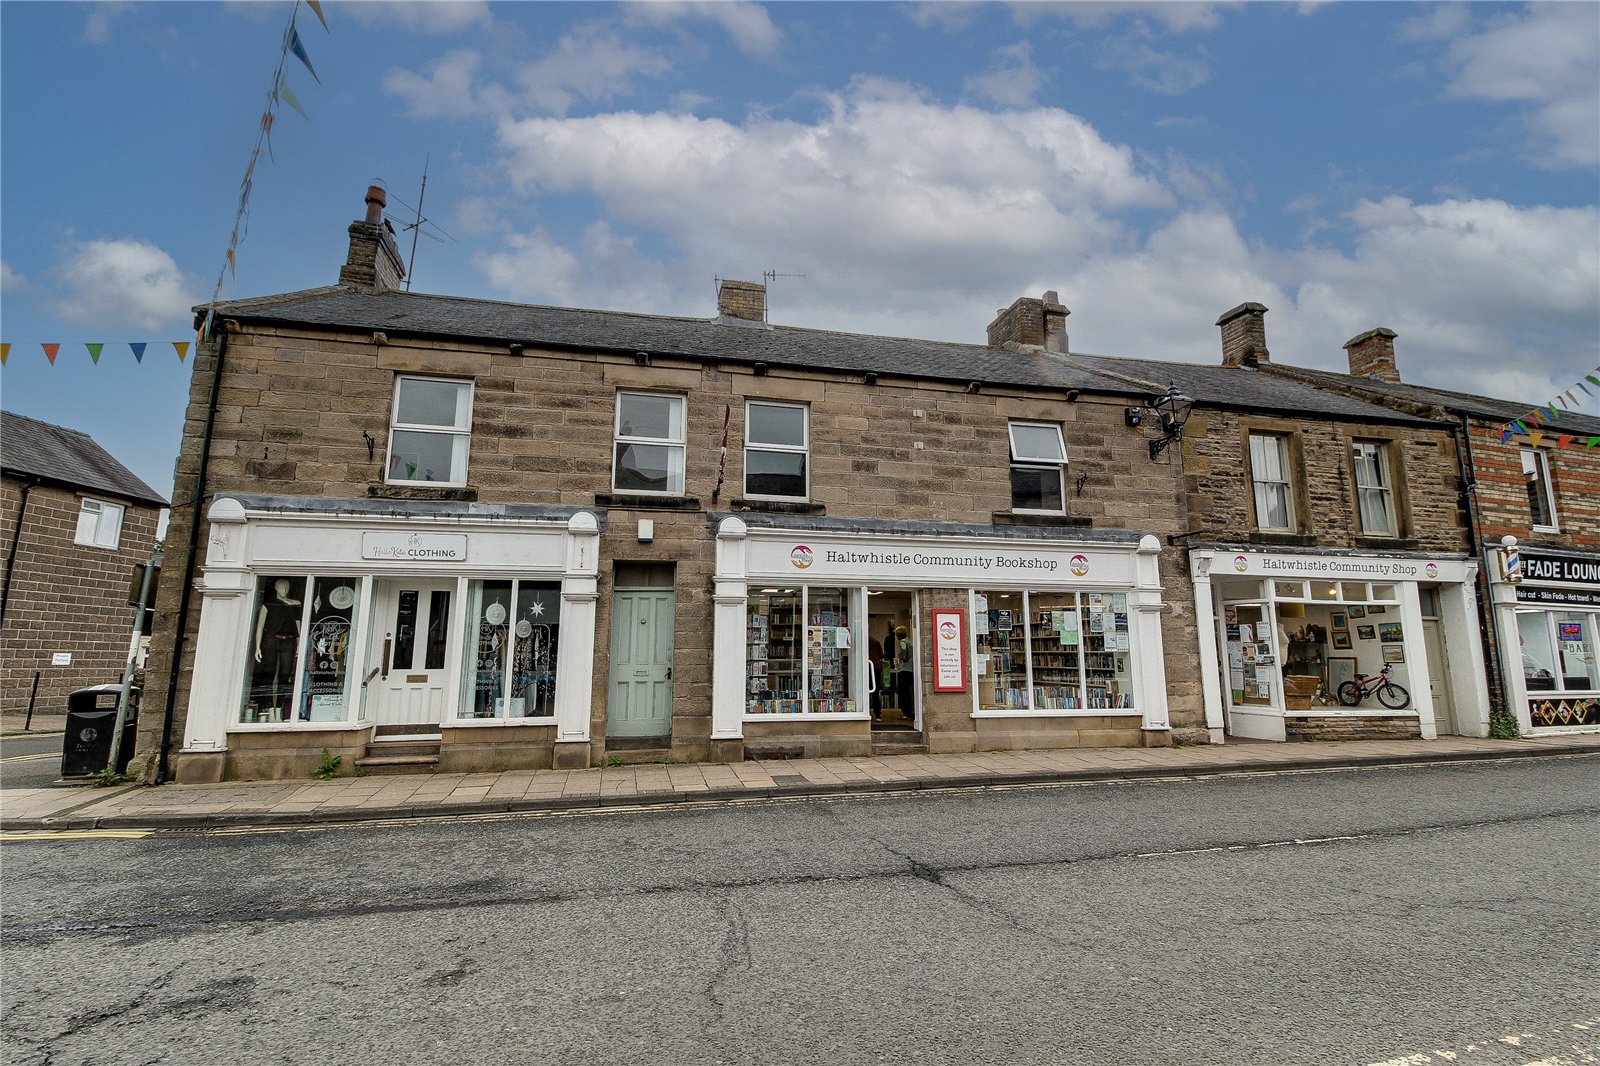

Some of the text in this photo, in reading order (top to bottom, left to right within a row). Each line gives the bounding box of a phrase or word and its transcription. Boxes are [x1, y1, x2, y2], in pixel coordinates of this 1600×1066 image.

[407, 548, 456, 558] CLOTHING
[826, 550, 911, 565] Haltwhistle
[913, 553, 993, 570] Community
[996, 556, 1058, 571] Bookshop
[1262, 558, 1328, 571] Haltwhistle
[1329, 561, 1390, 575] Community
[1392, 563, 1417, 577] Shop
[1527, 559, 1561, 578] FADE
[1516, 590, 1527, 598] Hair
[1527, 591, 1536, 599] cut
[1541, 591, 1552, 599] Skin
[1552, 592, 1565, 600] Fade
[1568, 593, 1576, 601] Hot
